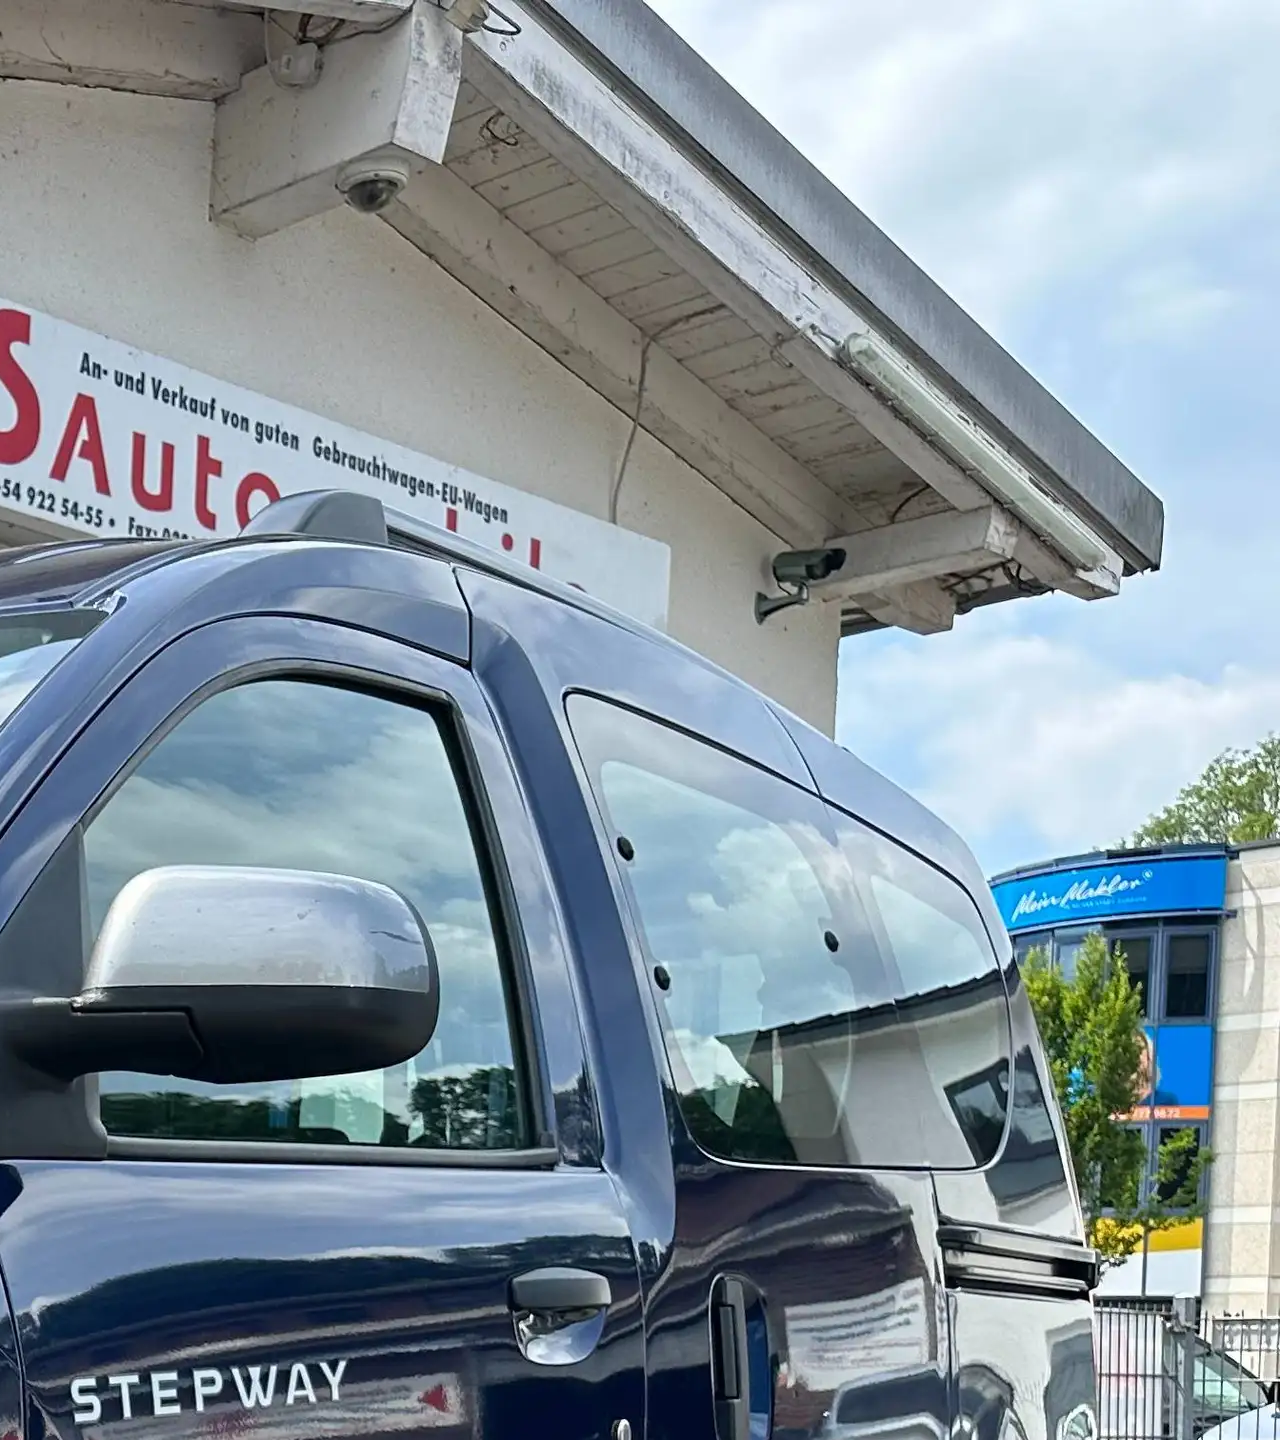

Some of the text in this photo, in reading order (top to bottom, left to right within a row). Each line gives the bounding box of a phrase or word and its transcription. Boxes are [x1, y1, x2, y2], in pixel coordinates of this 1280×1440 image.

[79, 352, 108, 380] An-
[114, 370, 145, 395] und
[151, 377, 216, 421] Verkauf
[221, 407, 250, 433] von
[255, 420, 300, 452] guten
[26, 486, 56, 513] 922
[60, 498, 104, 528] 54-55
[1011, 889, 1061, 924] Mein
[1059, 873, 1142, 909] Makler
[70, 1360, 349, 1427] STEPWAY
